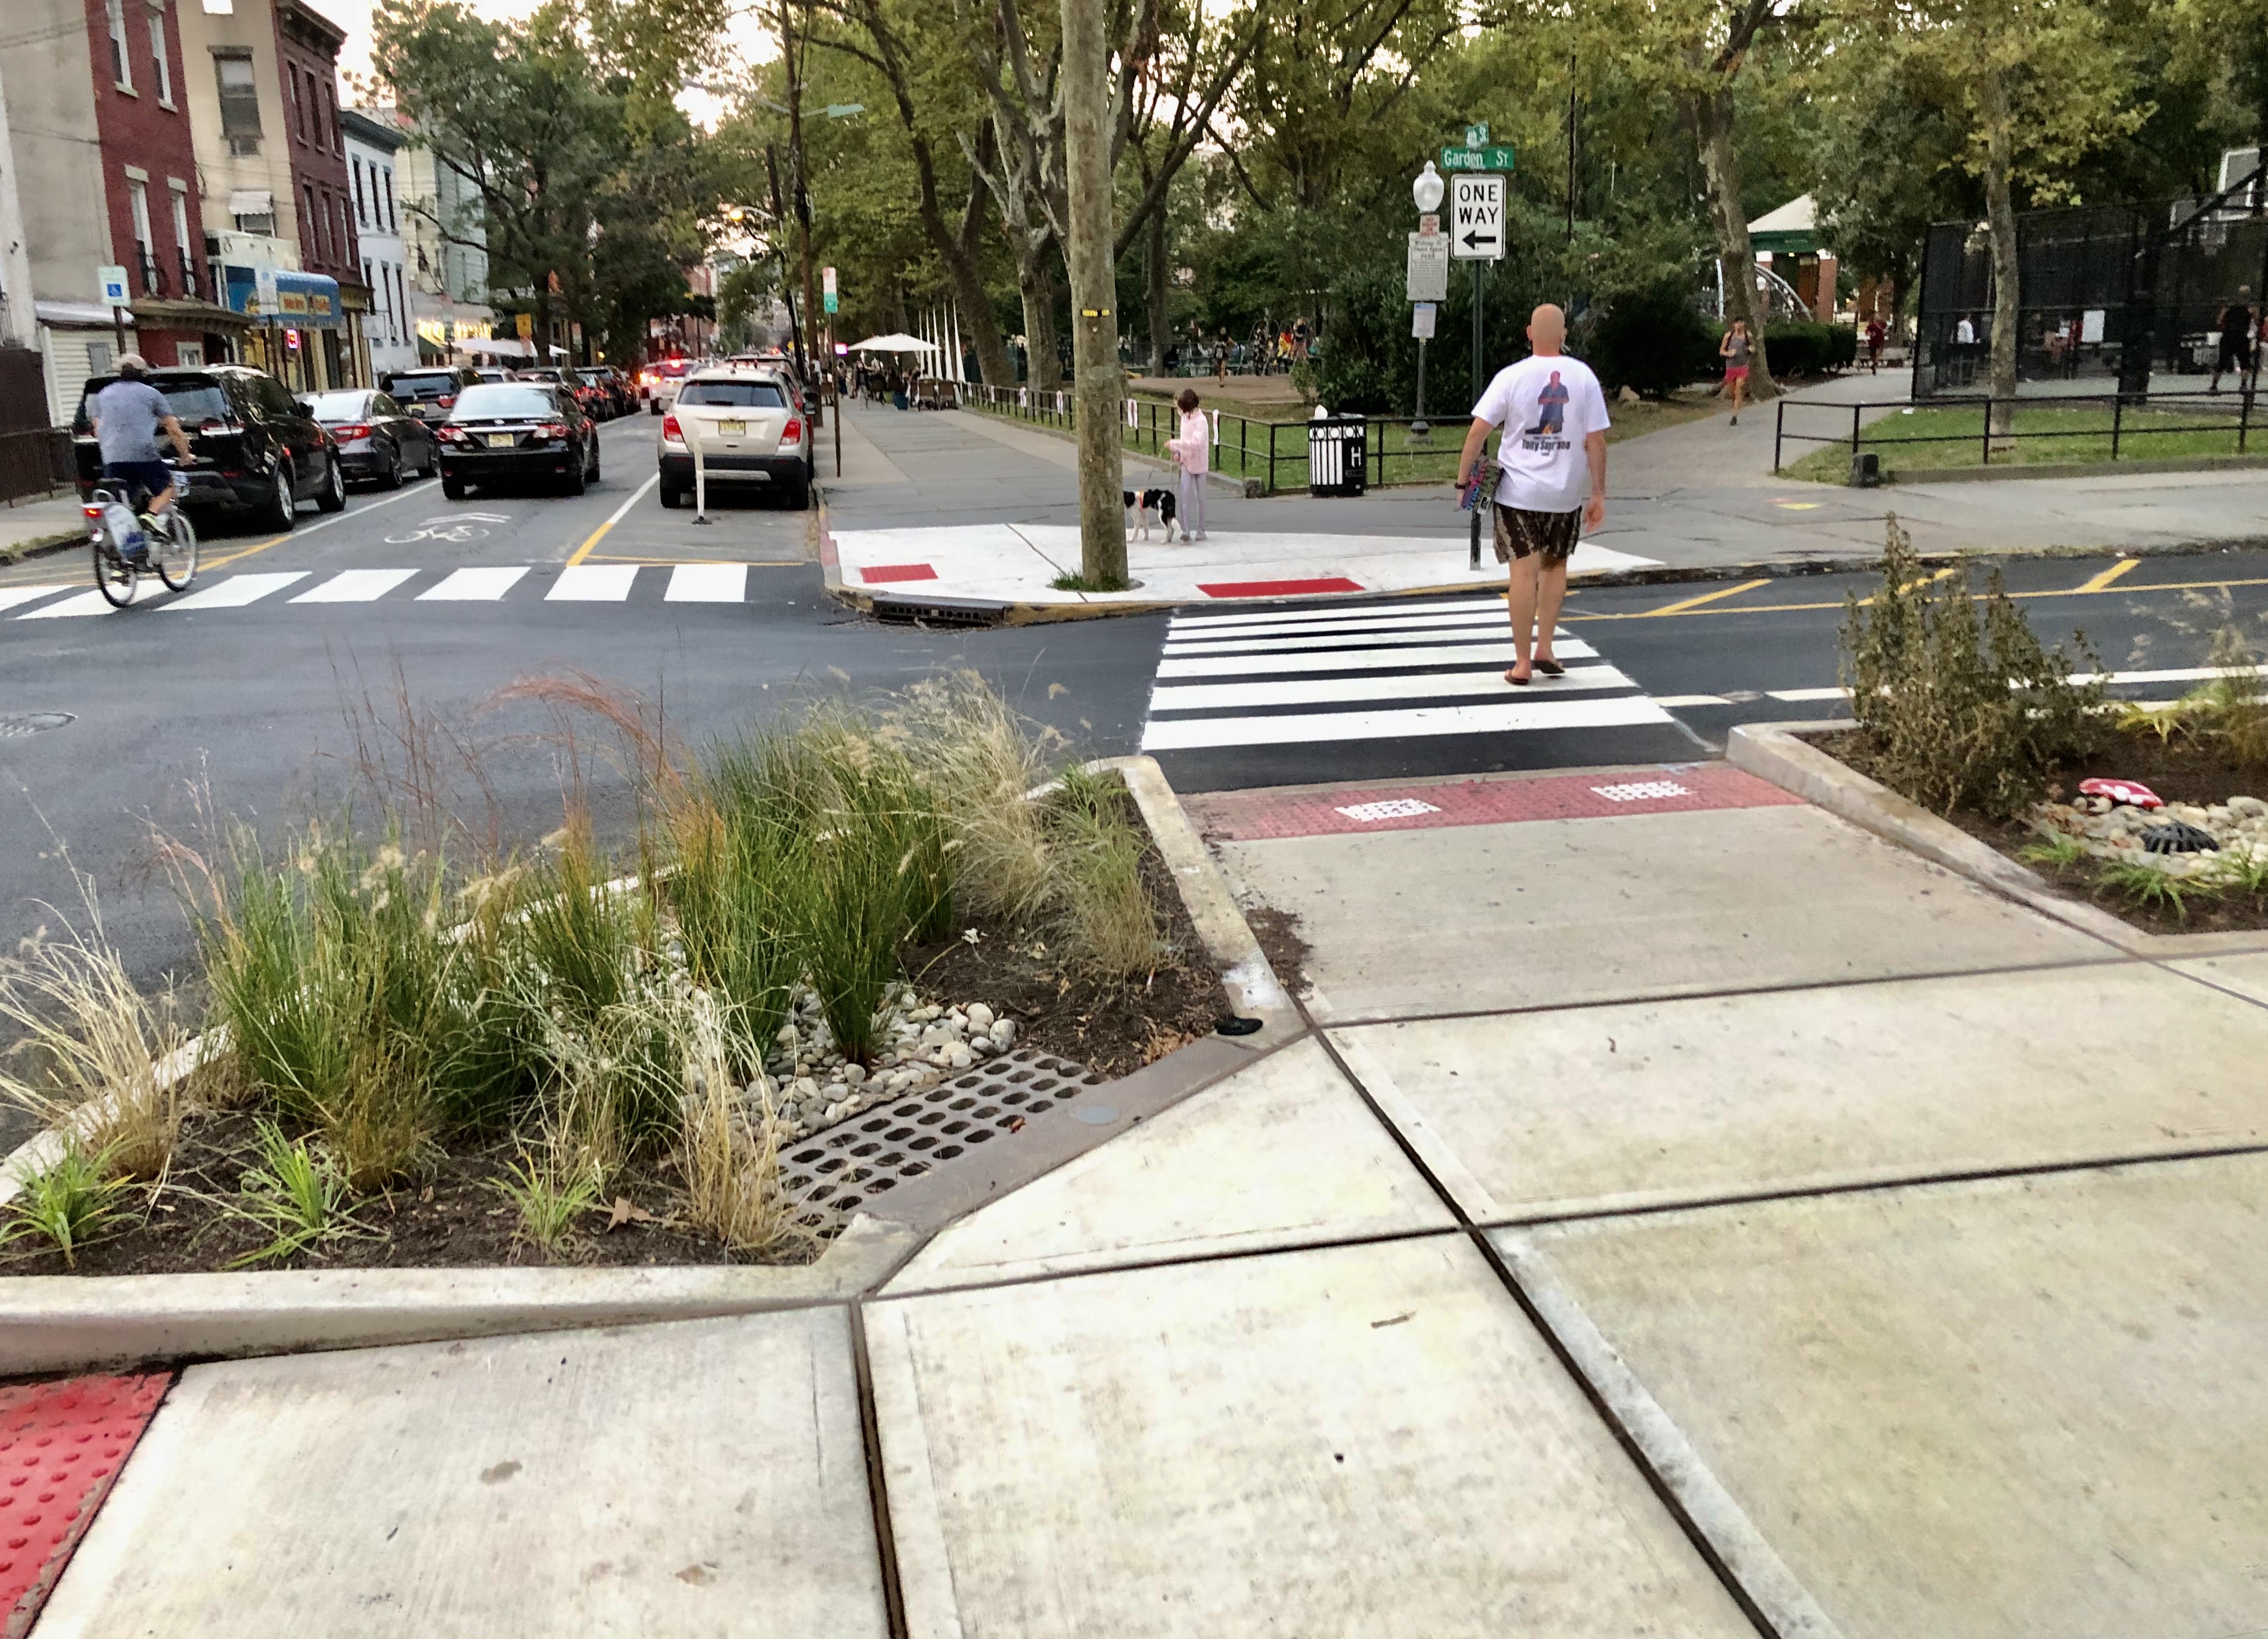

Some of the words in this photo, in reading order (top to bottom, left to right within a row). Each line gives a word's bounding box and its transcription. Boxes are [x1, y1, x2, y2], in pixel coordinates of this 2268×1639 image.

[1445, 150, 1483, 167] Garden
[1460, 184, 1498, 202] ONE
[1459, 207, 1498, 225] WAY
[1522, 439, 1540, 452] Tony
[1351, 446, 1362, 468] H
